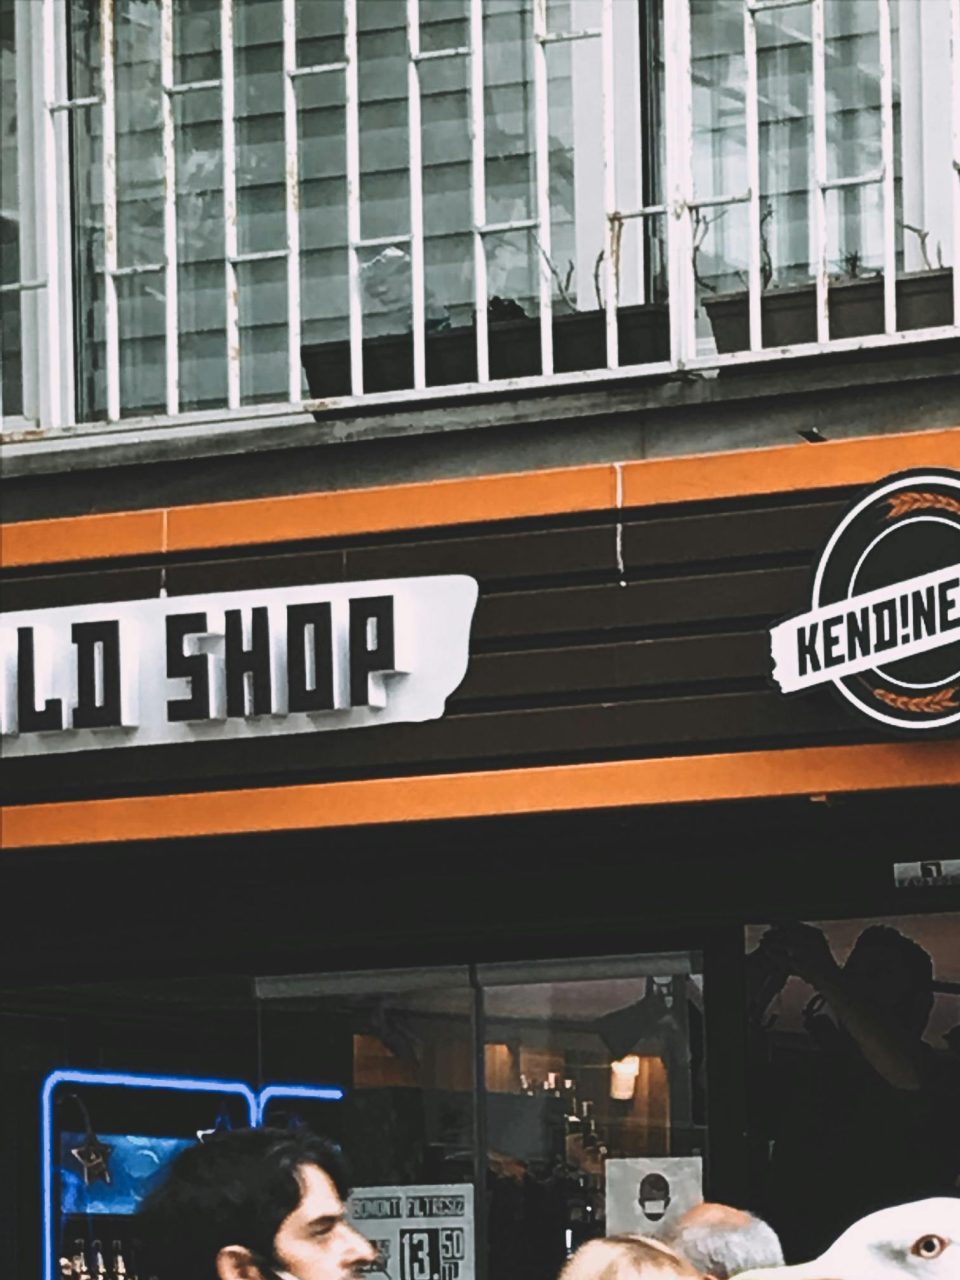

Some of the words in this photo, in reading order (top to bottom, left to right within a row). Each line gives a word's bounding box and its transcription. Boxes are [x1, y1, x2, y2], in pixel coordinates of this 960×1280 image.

[16, 619, 122, 733] LD
[165, 594, 396, 722] SHOP
[441, 1229, 463, 1259] 50
